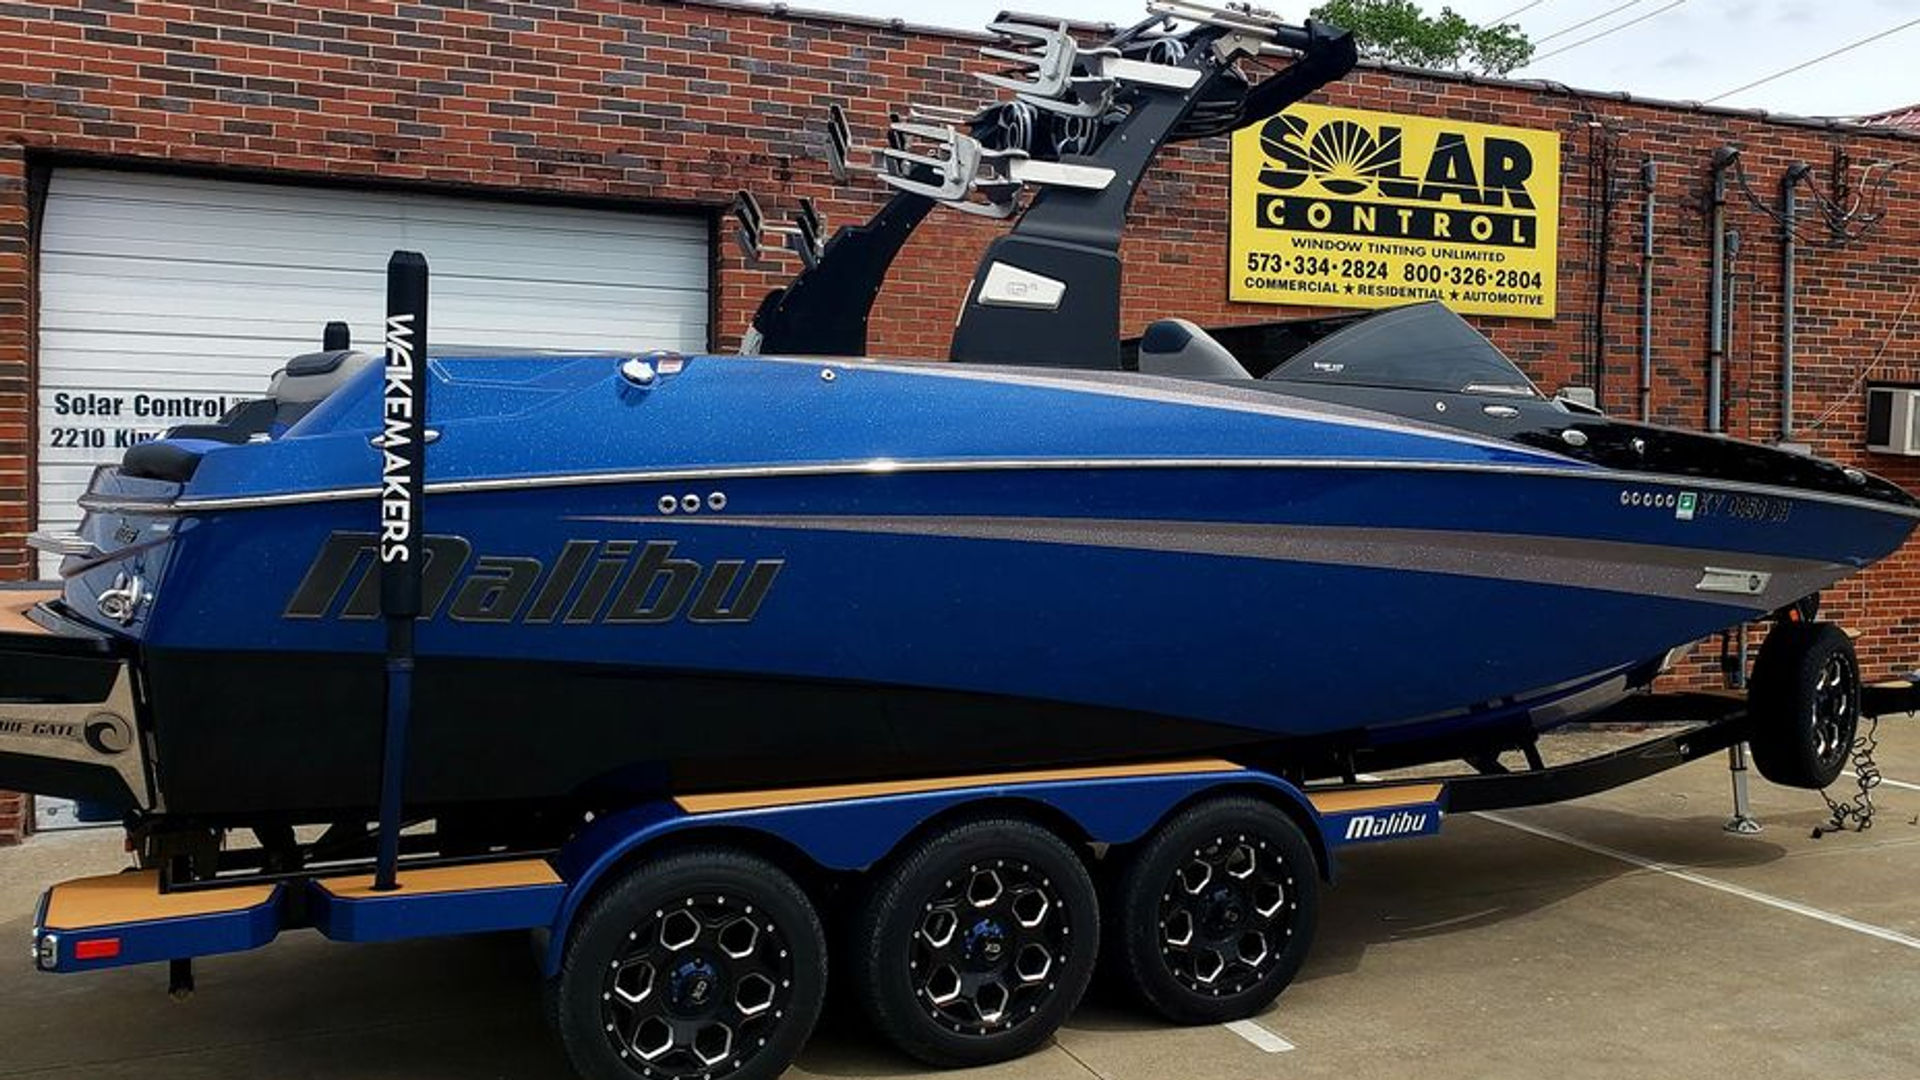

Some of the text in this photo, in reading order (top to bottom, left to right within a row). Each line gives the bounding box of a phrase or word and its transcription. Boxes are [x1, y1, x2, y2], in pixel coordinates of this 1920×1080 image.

[1257, 114, 1536, 210] SOLAR
[1266, 199, 1526, 243] CONTROL
[1291, 237, 1505, 262] WINDOW TINTING UNLIMITED
[1244, 276, 1544, 305] COMMERCIAL RESIDENTIAL AUTOMOTIVE
[54, 393, 226, 417] Solar Control
[51, 428, 160, 448] 2210 Kin
[381, 314, 415, 563] WAKEMAKERS
[281, 531, 786, 625] Malibu
[1345, 811, 1427, 839] Malibu
